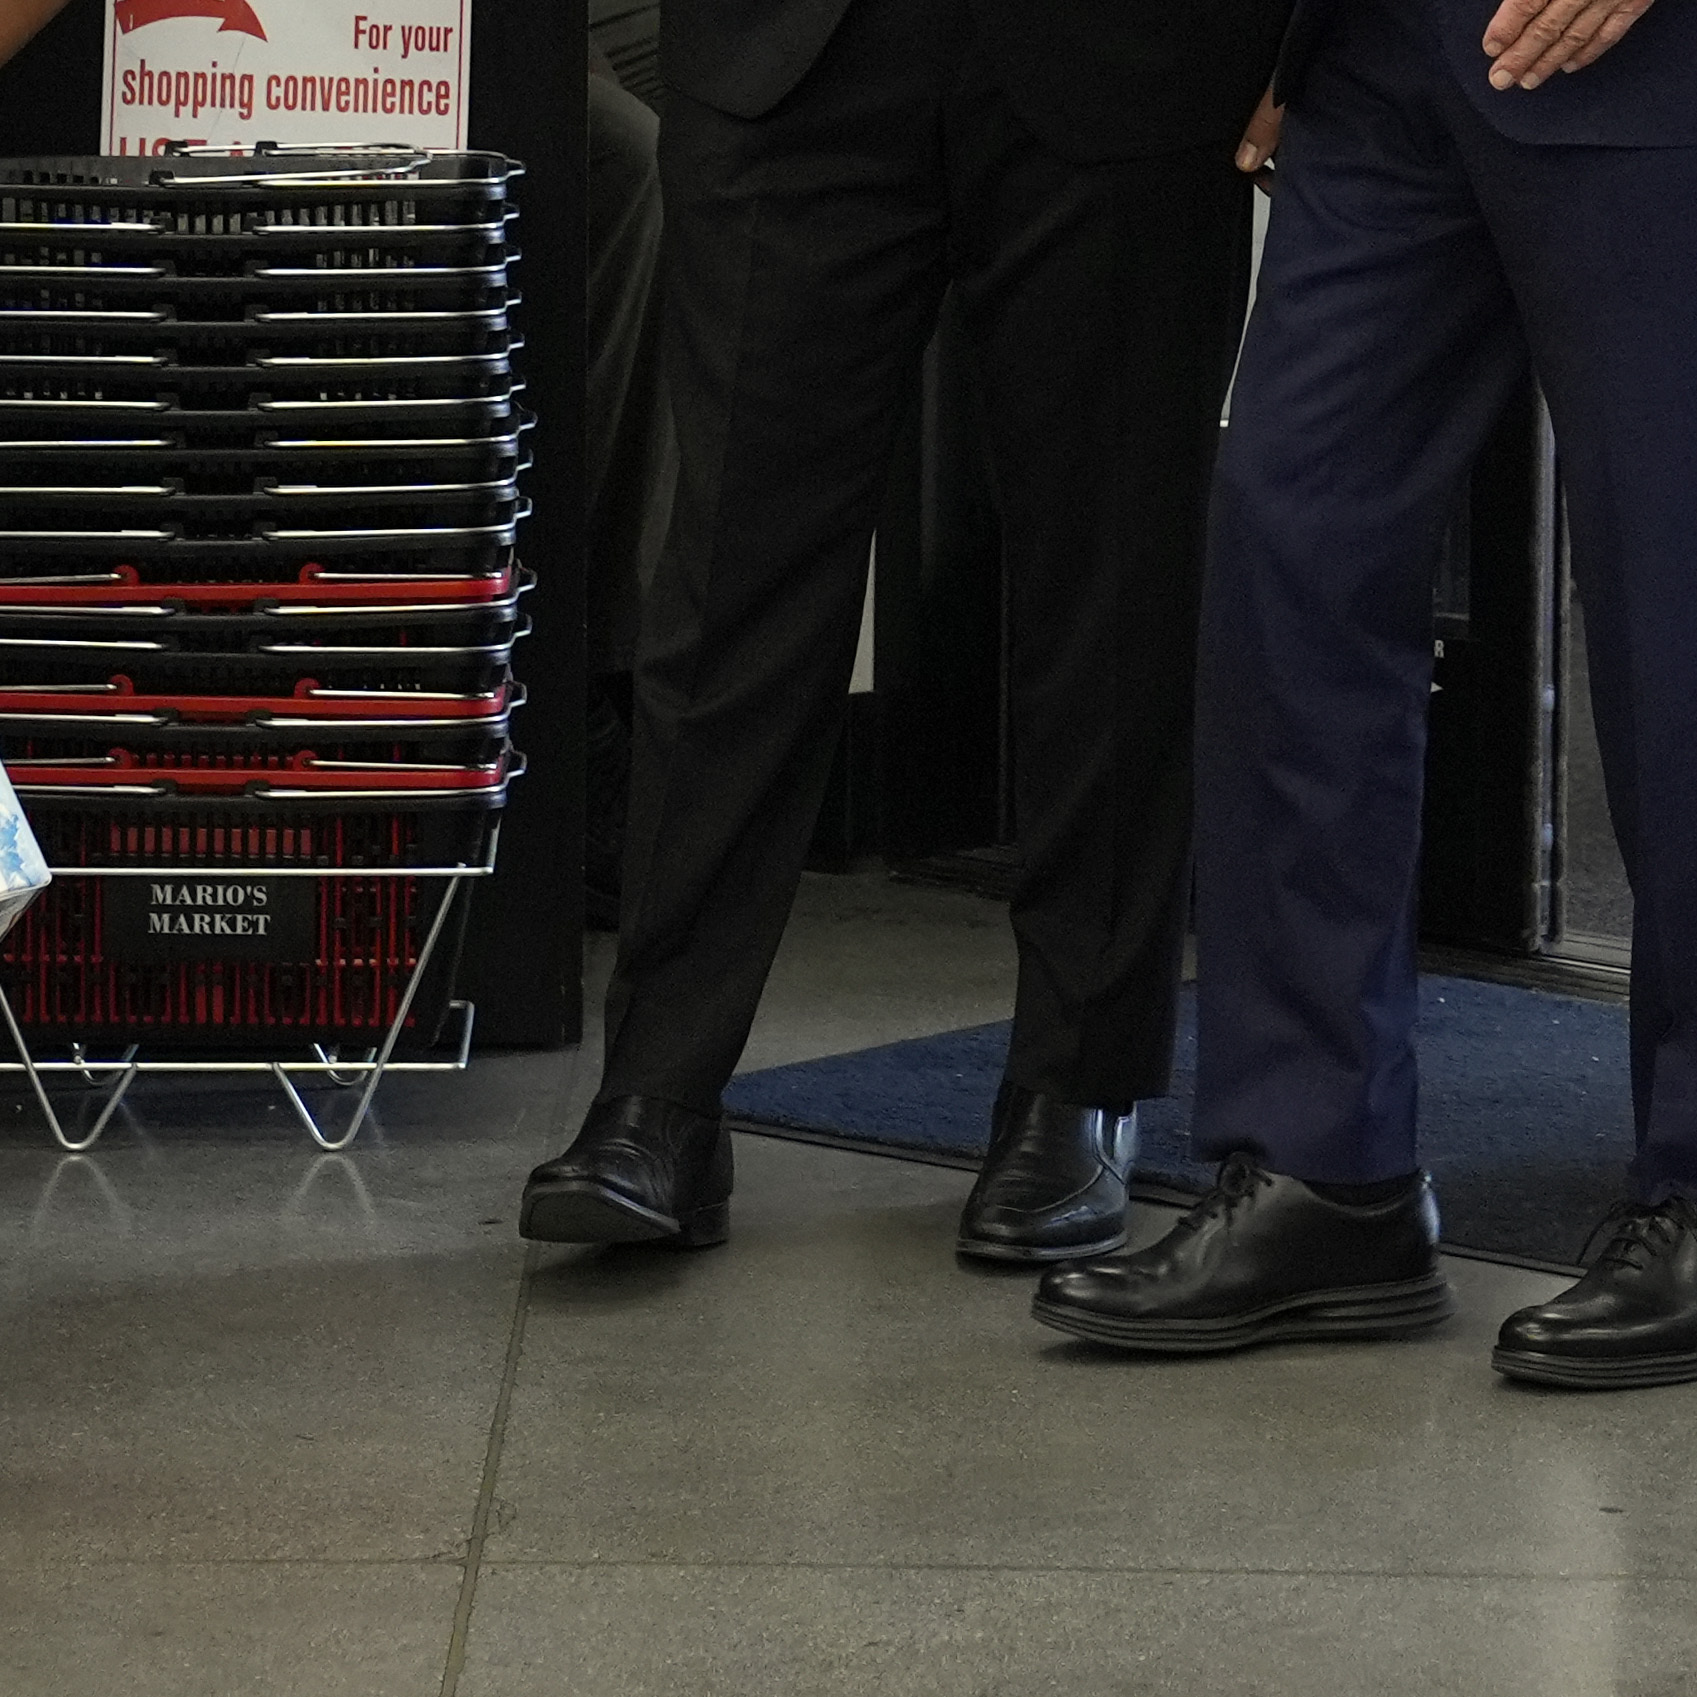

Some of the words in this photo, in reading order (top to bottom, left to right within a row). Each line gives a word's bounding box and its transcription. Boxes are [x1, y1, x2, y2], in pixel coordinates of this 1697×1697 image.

[354, 15, 392, 50] For
[401, 25, 453, 58] your
[122, 60, 254, 120] shopping
[266, 67, 450, 116] convenience
[150, 884, 268, 906] MARIO'S
[148, 914, 270, 935] MARKET
